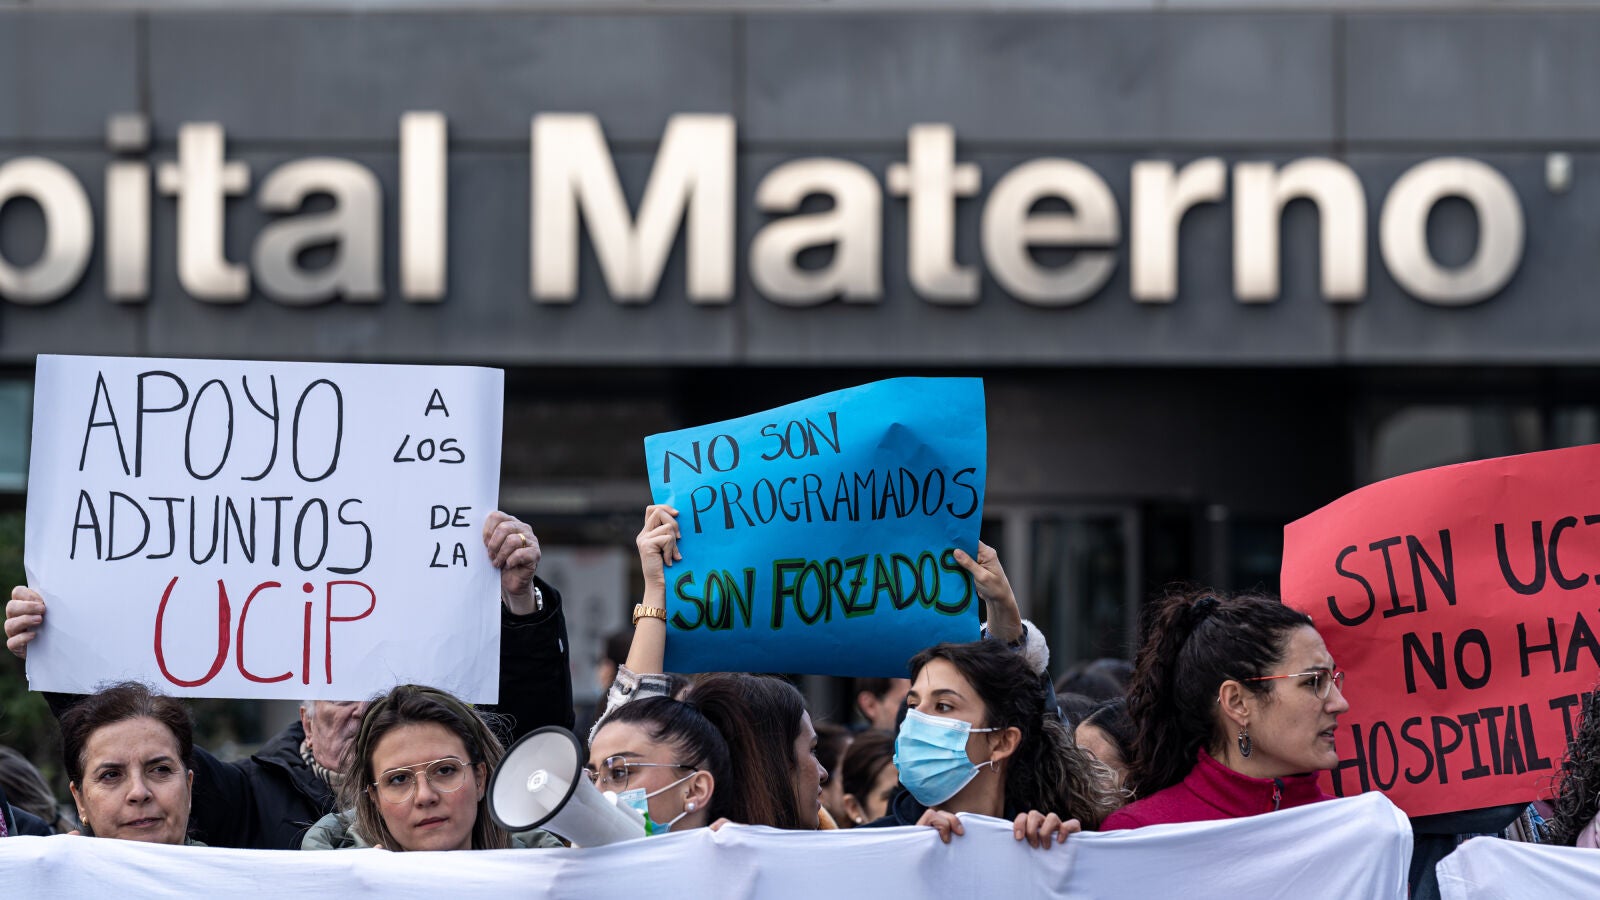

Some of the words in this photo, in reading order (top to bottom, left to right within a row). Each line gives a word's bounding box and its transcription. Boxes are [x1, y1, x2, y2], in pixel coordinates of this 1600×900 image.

[530, 112, 1525, 305] Materno
[79, 370, 343, 482] APOYO
[424, 388, 450, 418] A
[393, 434, 466, 464] LOS
[663, 434, 740, 484] NO
[760, 411, 841, 461] SON
[70, 489, 373, 575] ADJUNTOS
[430, 505, 472, 530] DE
[690, 467, 979, 534] PROGRAMADOS
[429, 542, 468, 568] LA
[669, 569, 756, 632] SON
[770, 547, 974, 629] FORZADOS
[1327, 528, 1457, 627] SIN
[1402, 628, 1492, 695] NO
[1516, 608, 1600, 678] HA
[1331, 703, 1553, 798] HOSPITAL
